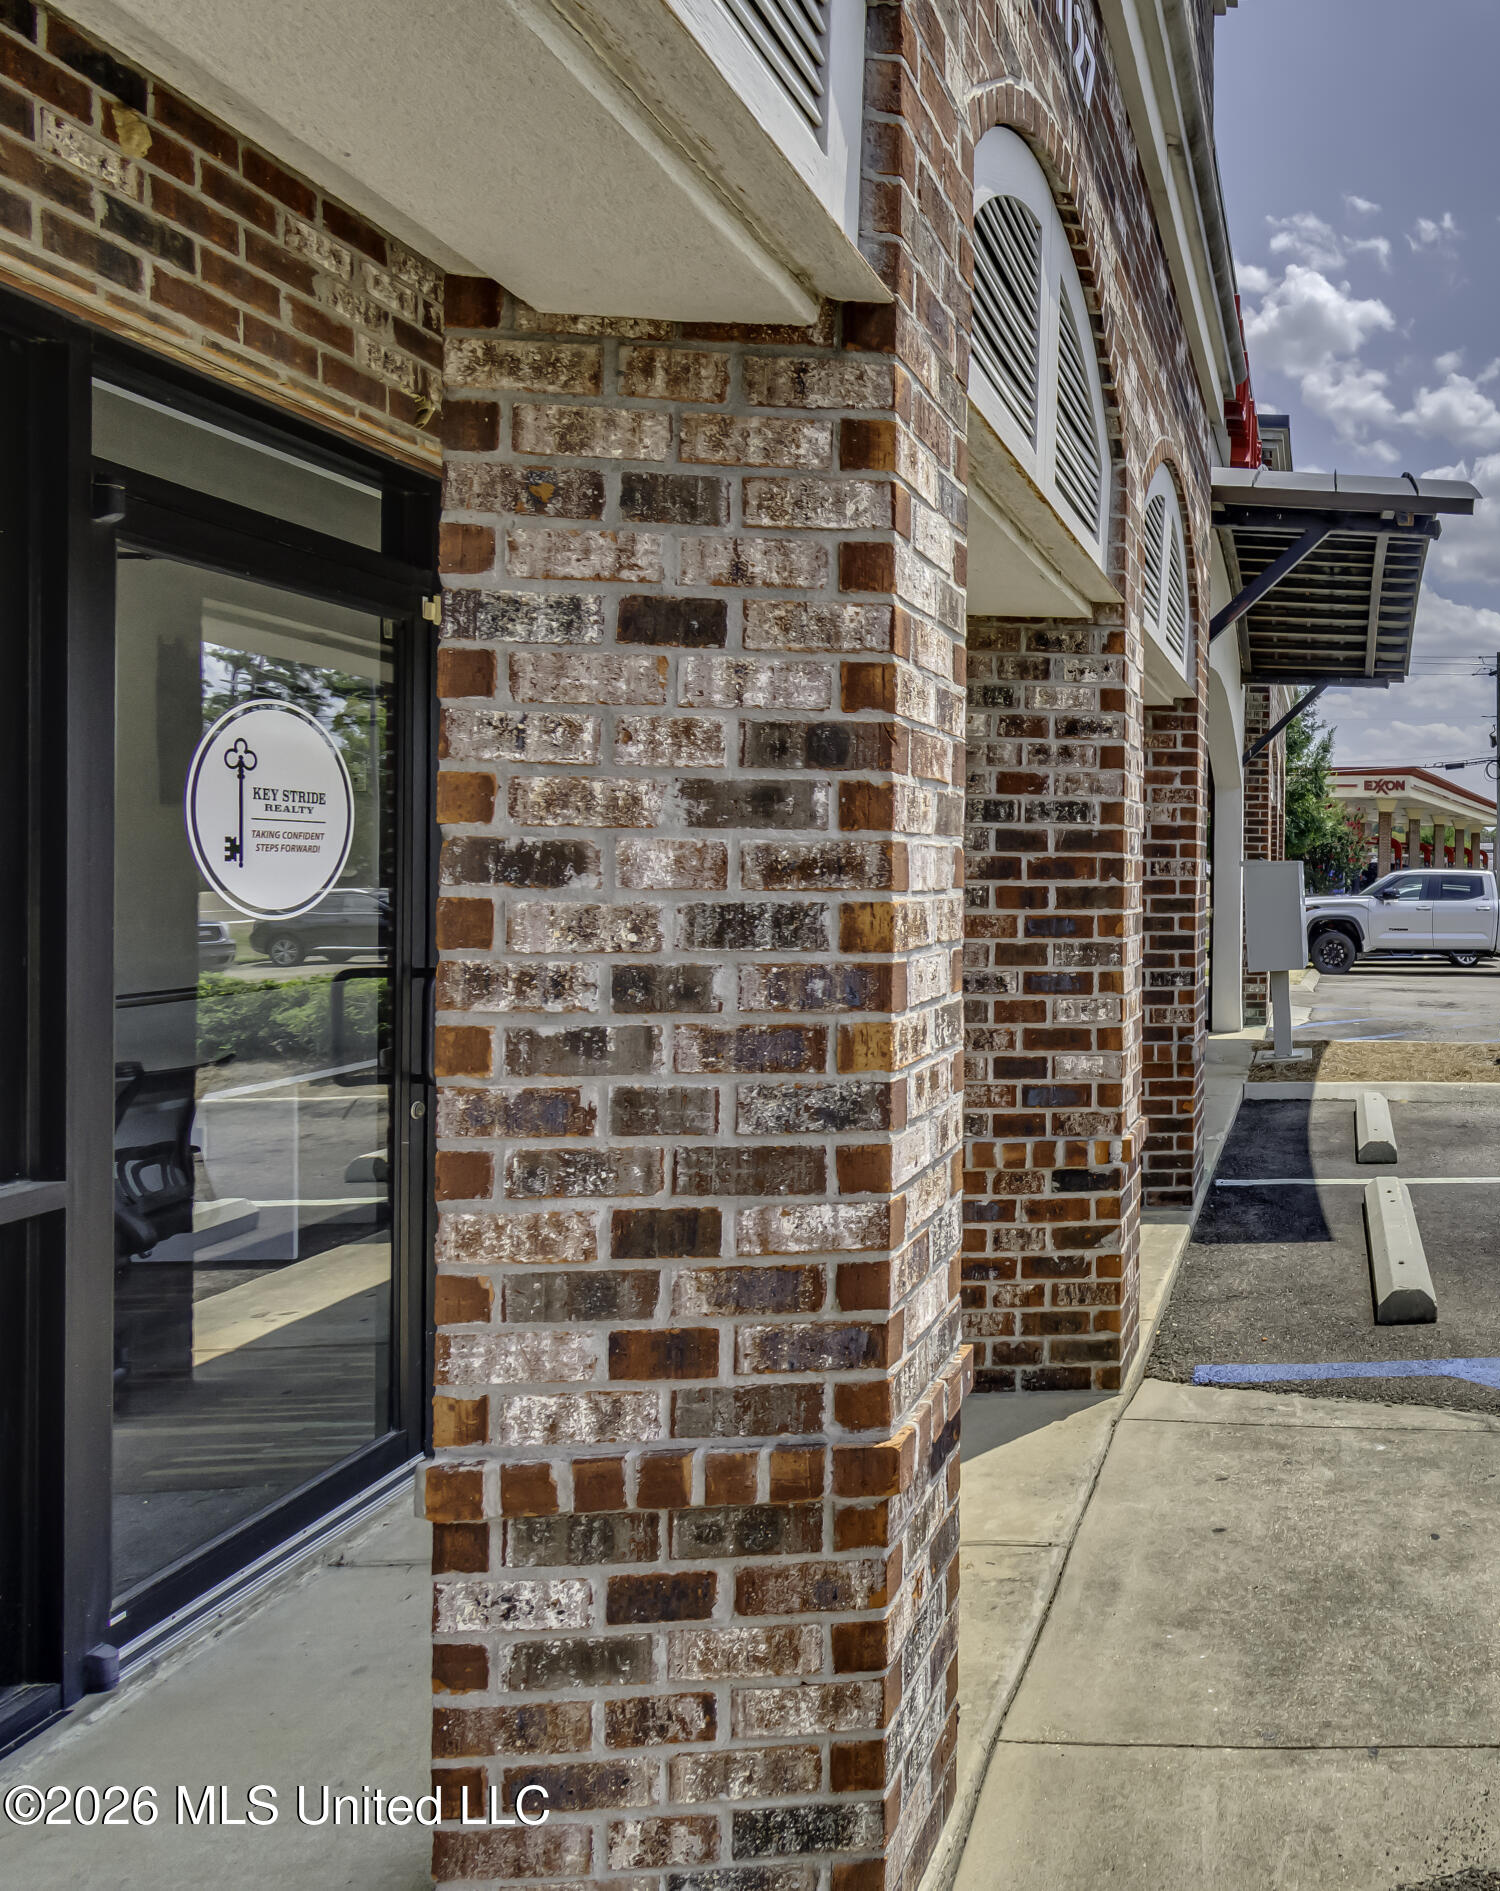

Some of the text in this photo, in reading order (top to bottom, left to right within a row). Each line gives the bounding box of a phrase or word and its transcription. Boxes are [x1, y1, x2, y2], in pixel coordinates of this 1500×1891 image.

[1363, 779, 1405, 795] EXXON
[252, 787, 326, 805] KEY STRIDE
[264, 803, 314, 814] REALTY
[251, 829, 325, 840] TAKING CONFIDENT
[255, 843, 320, 853] STEPS FORWARD!
